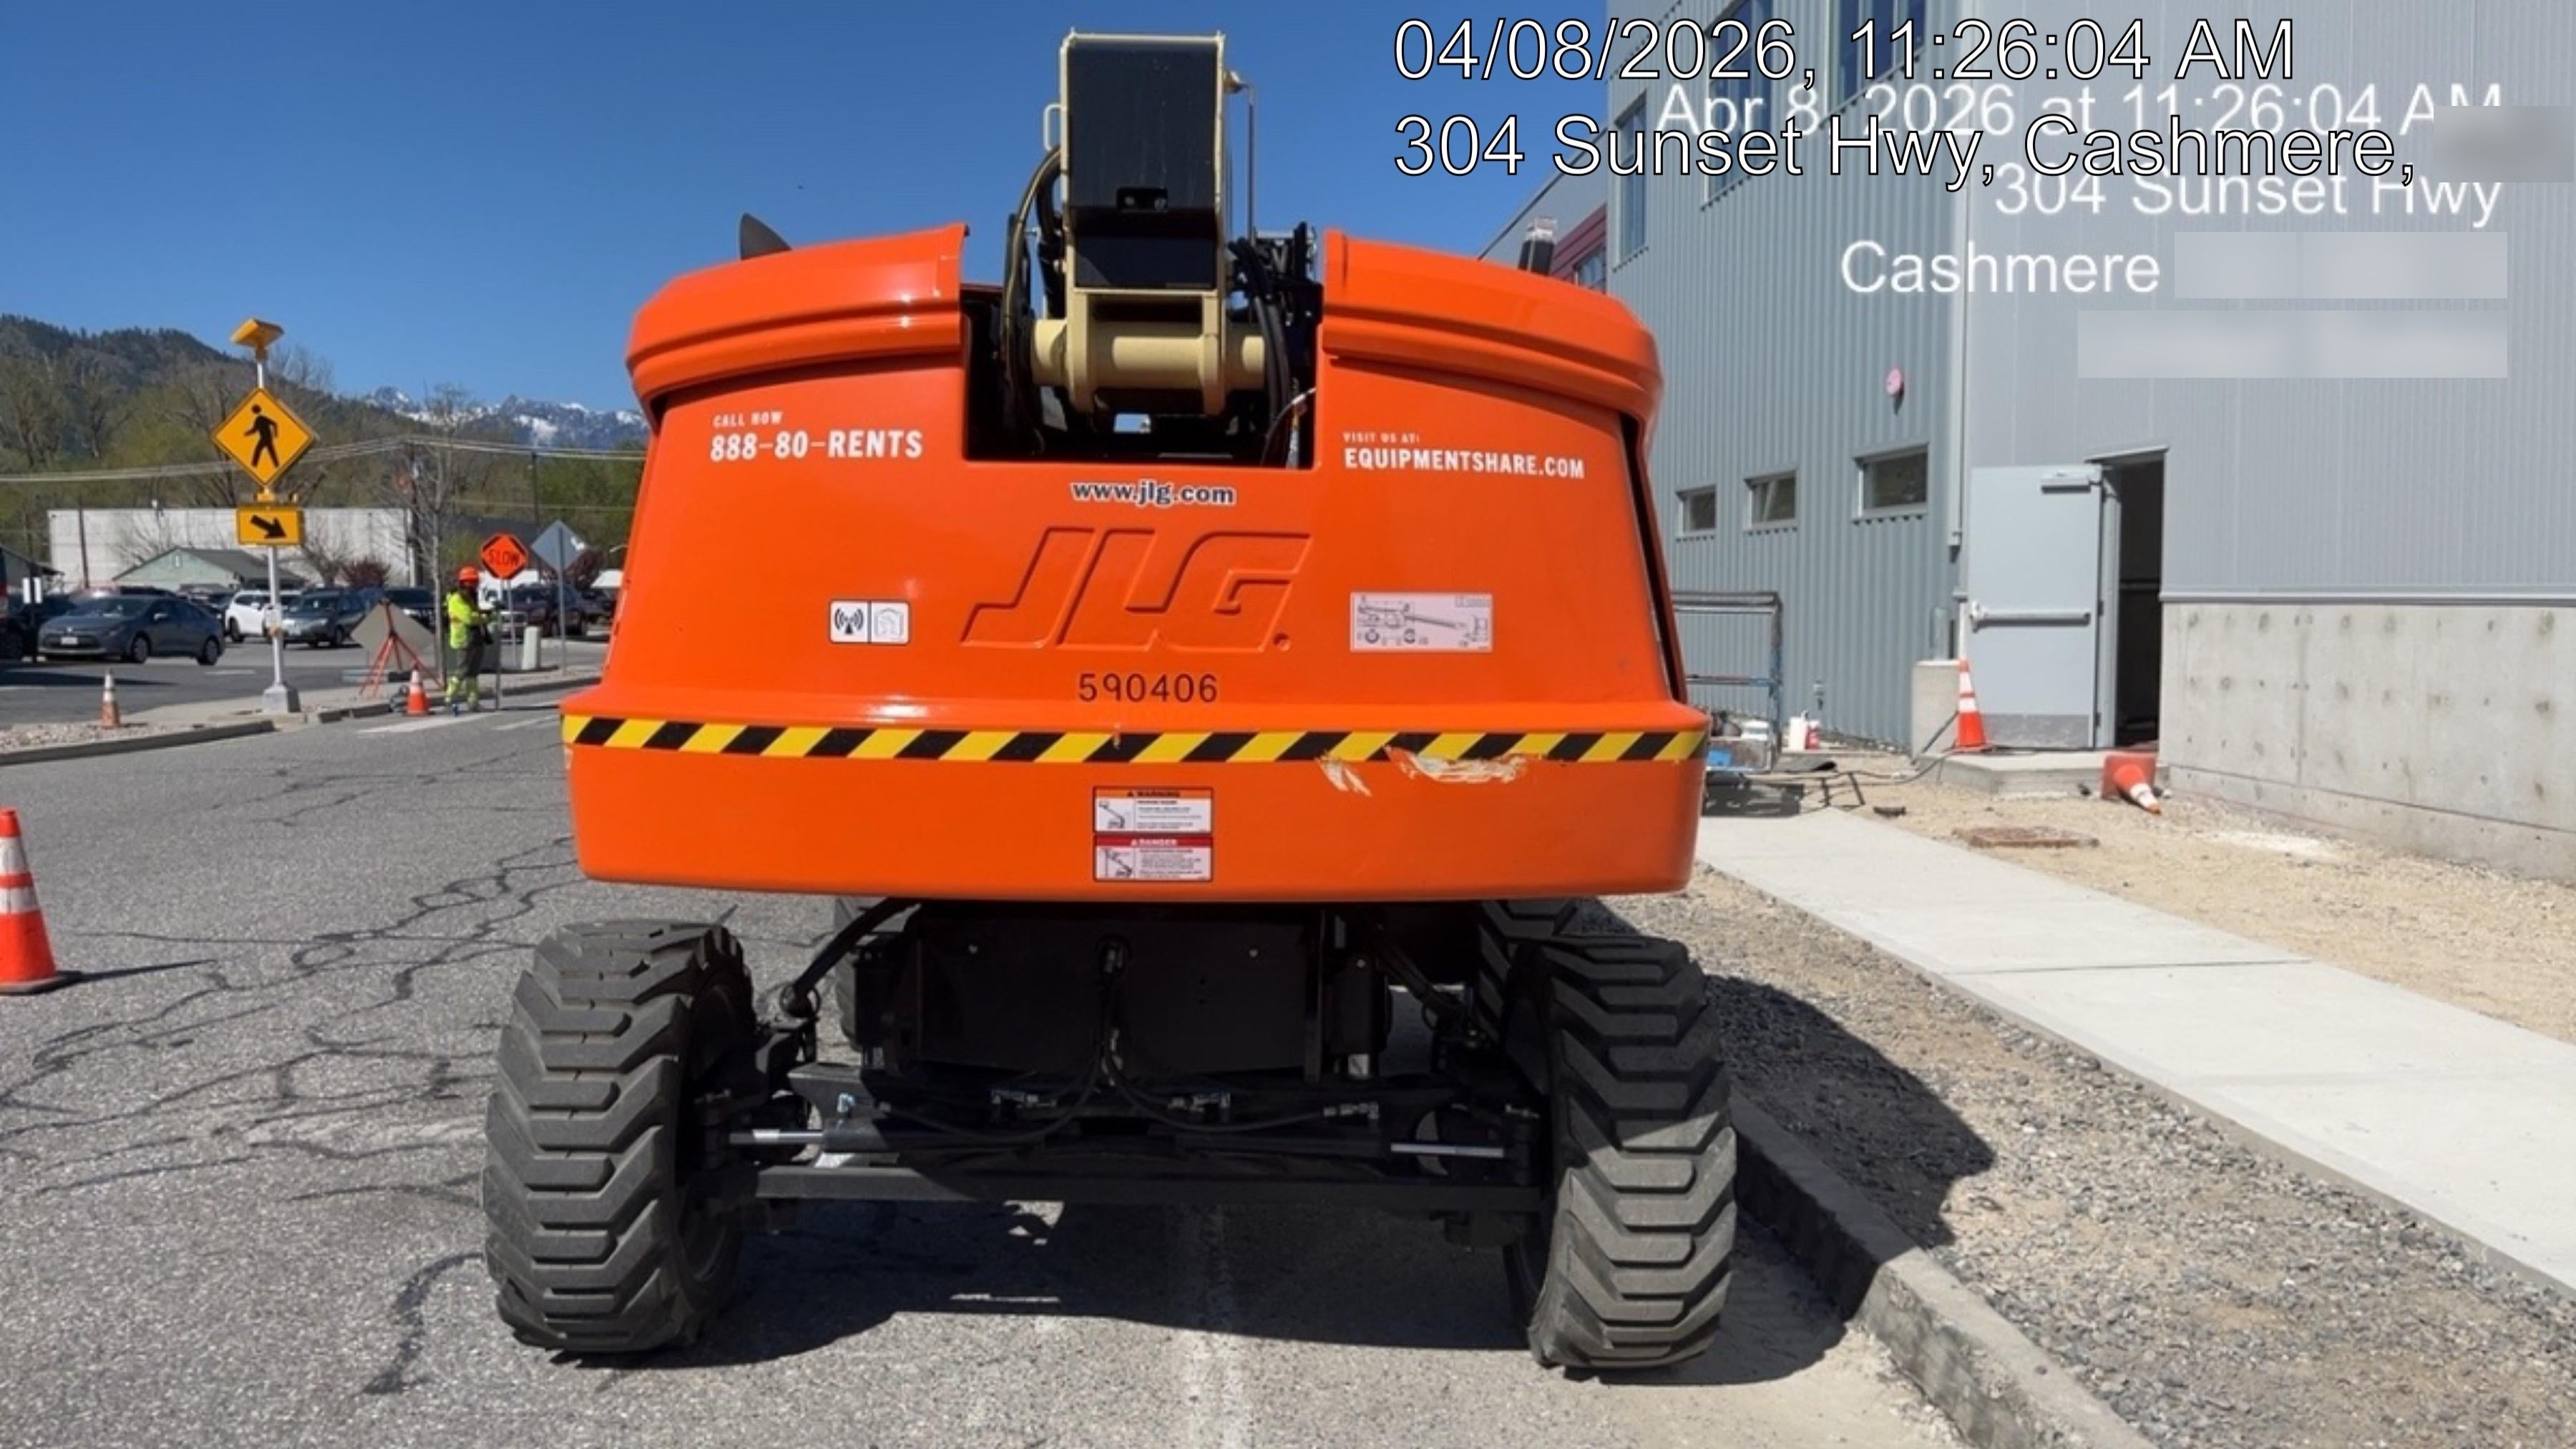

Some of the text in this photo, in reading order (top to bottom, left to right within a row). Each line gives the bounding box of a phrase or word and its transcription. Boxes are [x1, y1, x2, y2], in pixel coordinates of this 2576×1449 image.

[713, 411, 783, 428] CALL NOW
[710, 429, 924, 462] 888-80-RENTS
[1342, 431, 1376, 444] VISIT
[1380, 431, 1397, 444] US
[1344, 447, 1586, 479] EQUIPMENTSHARE.COM
[1071, 480, 1236, 507] www.jlg.com
[488, 548, 521, 568] SLOW
[961, 526, 1312, 653] JLG
[1078, 673, 1219, 703] 590406
